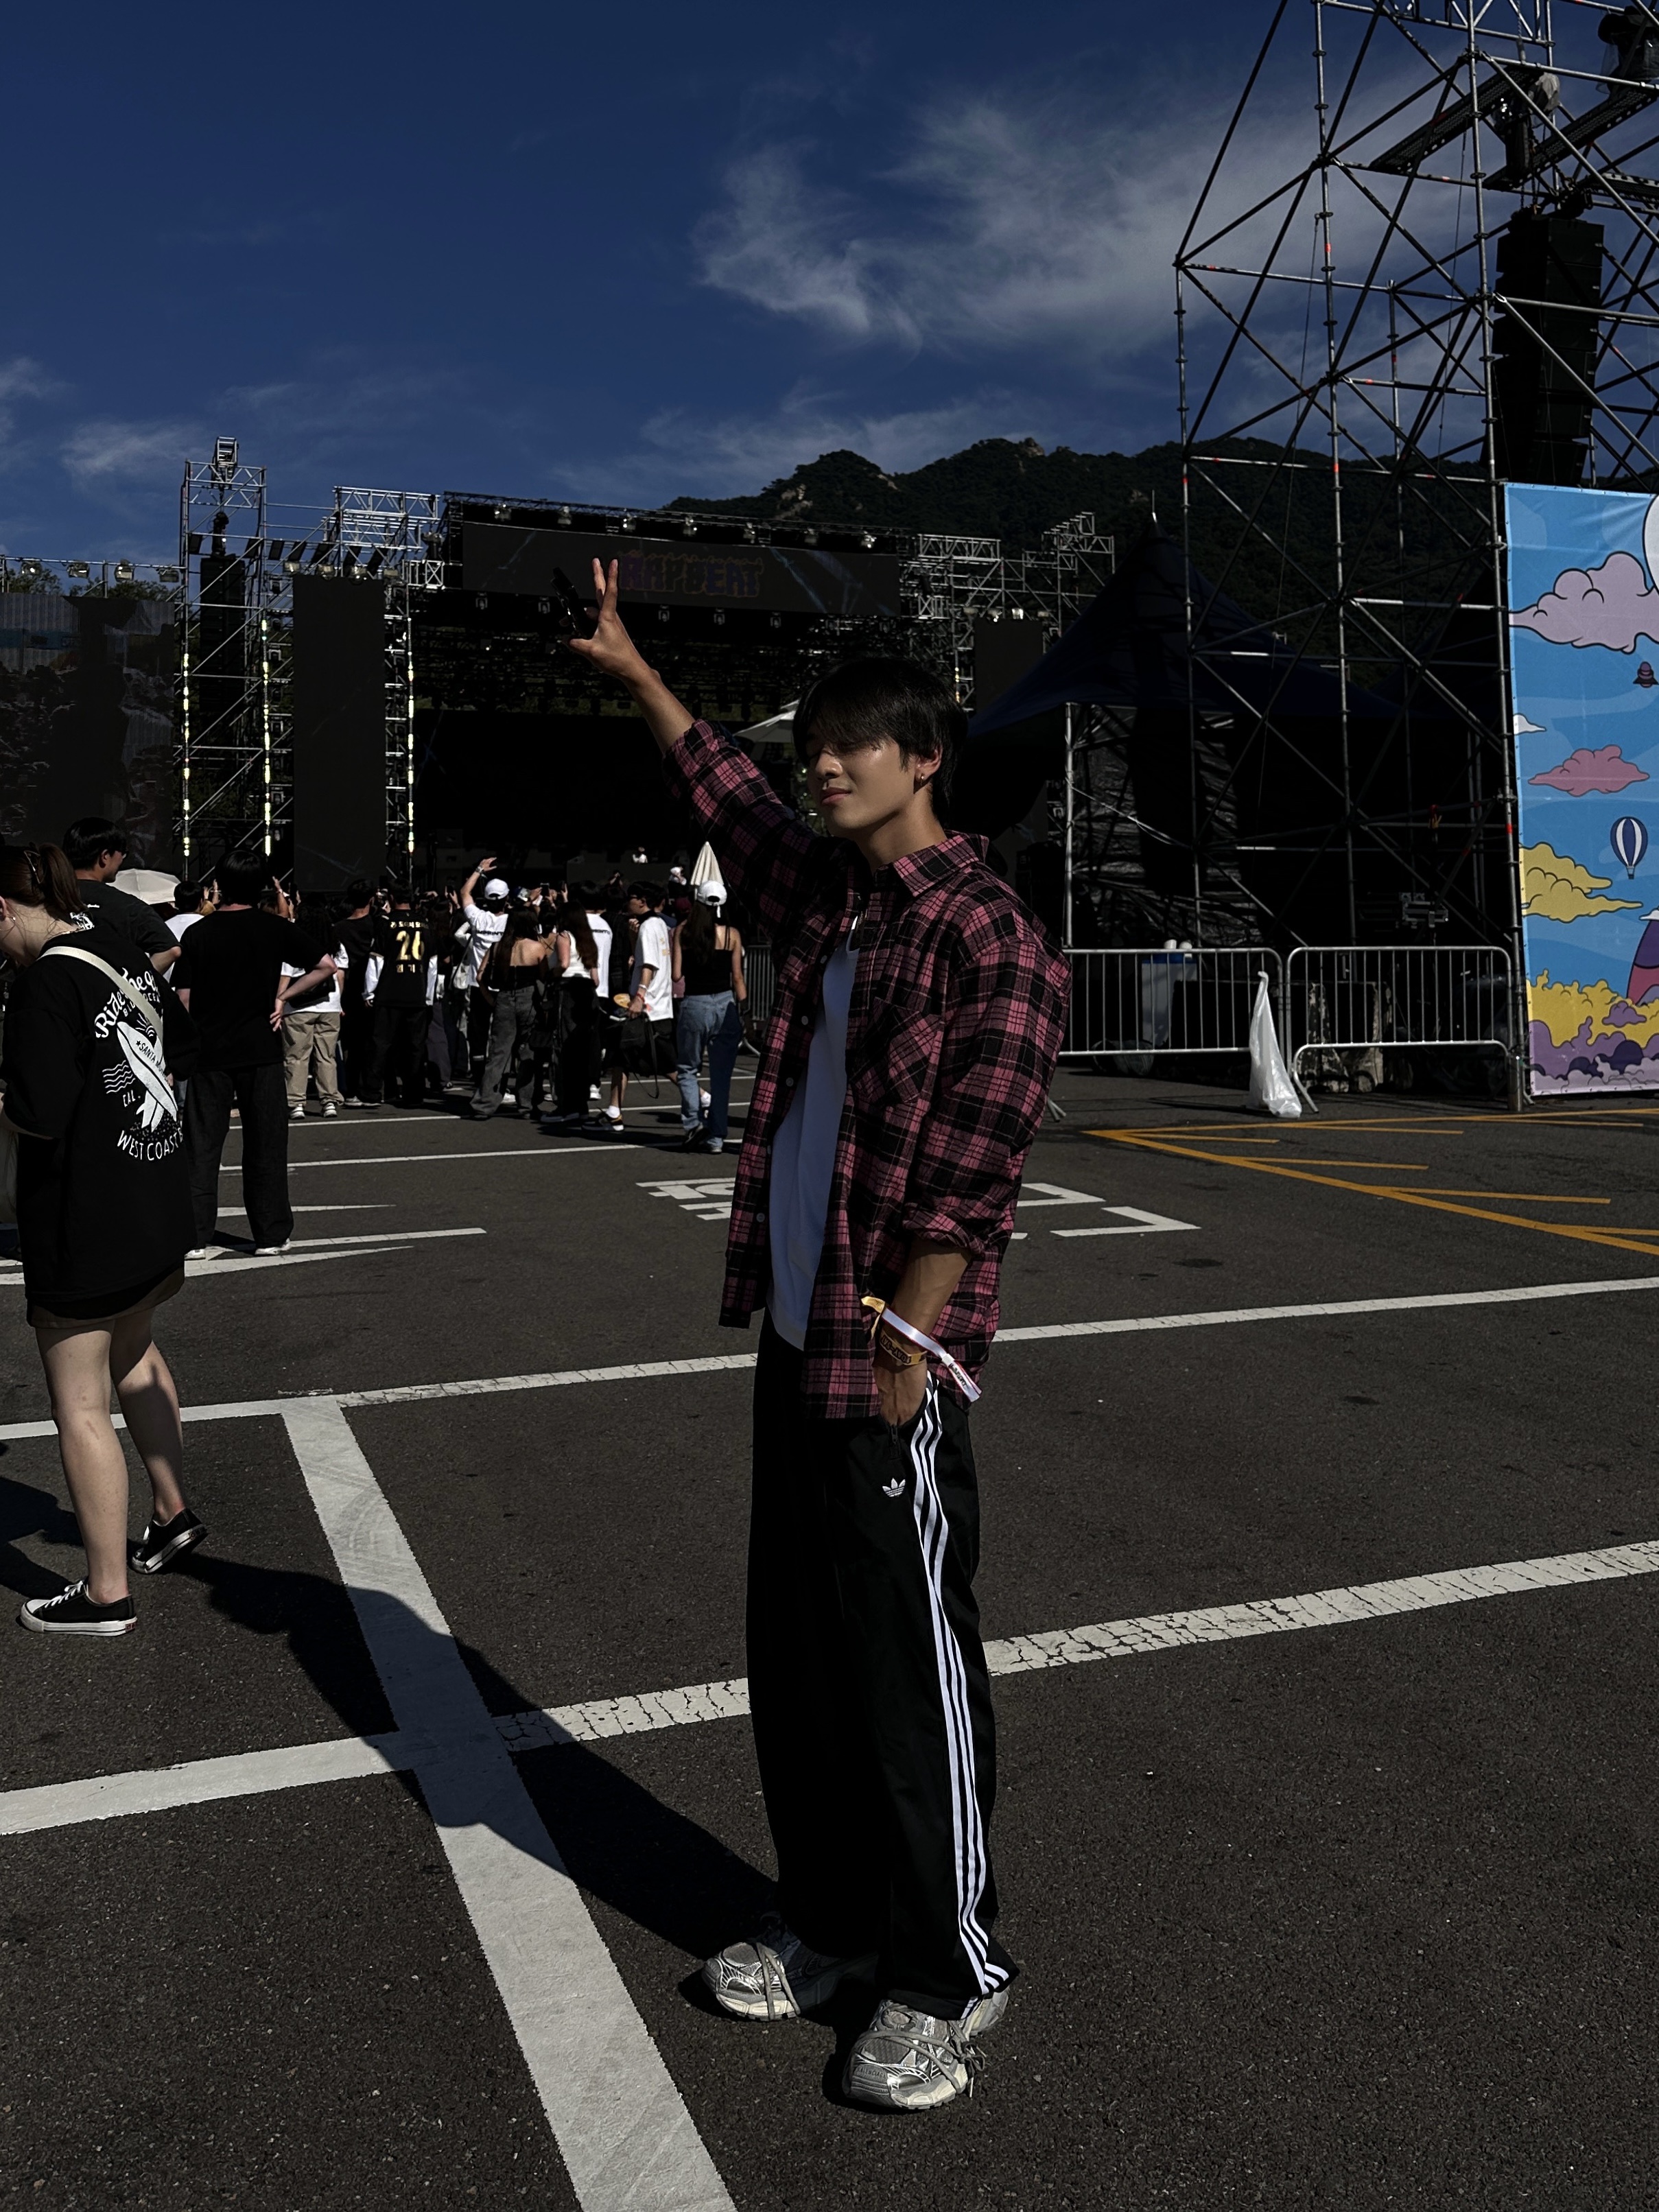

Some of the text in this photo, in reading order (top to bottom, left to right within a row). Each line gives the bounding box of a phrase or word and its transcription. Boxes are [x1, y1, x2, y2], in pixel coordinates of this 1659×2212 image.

[395, 930, 425, 961] 26
[139, 1042, 156, 1063] SANTA
[117, 1129, 144, 1161] WEST
